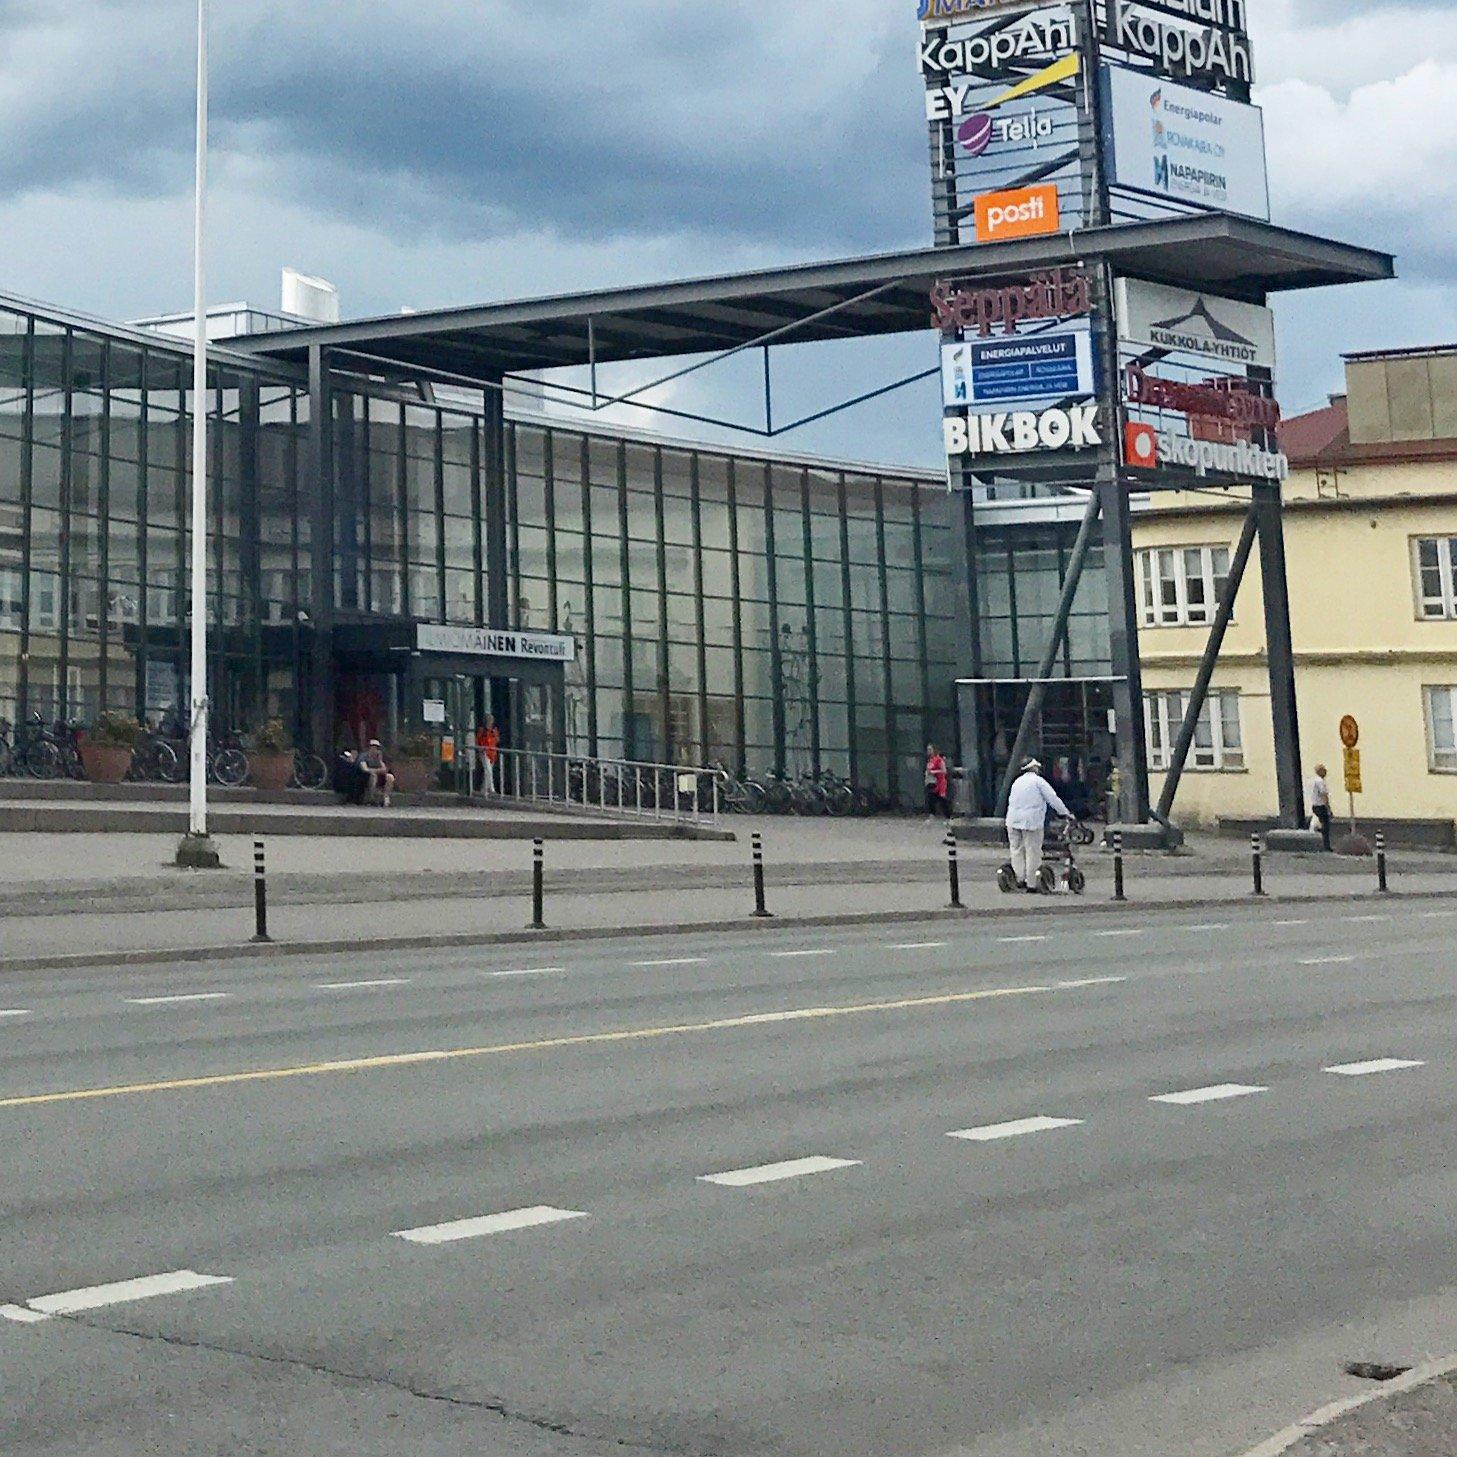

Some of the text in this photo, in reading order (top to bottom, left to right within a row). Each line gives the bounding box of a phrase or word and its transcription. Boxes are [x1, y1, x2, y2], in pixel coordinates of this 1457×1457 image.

[916, 13, 1078, 74] KappAhl
[925, 83, 971, 121] EY
[1163, 99, 1223, 126] Energiapolar
[996, 110, 1053, 142] Telia
[987, 196, 1044, 233] posti
[980, 342, 1067, 361] ENERGIAPALVELUT
